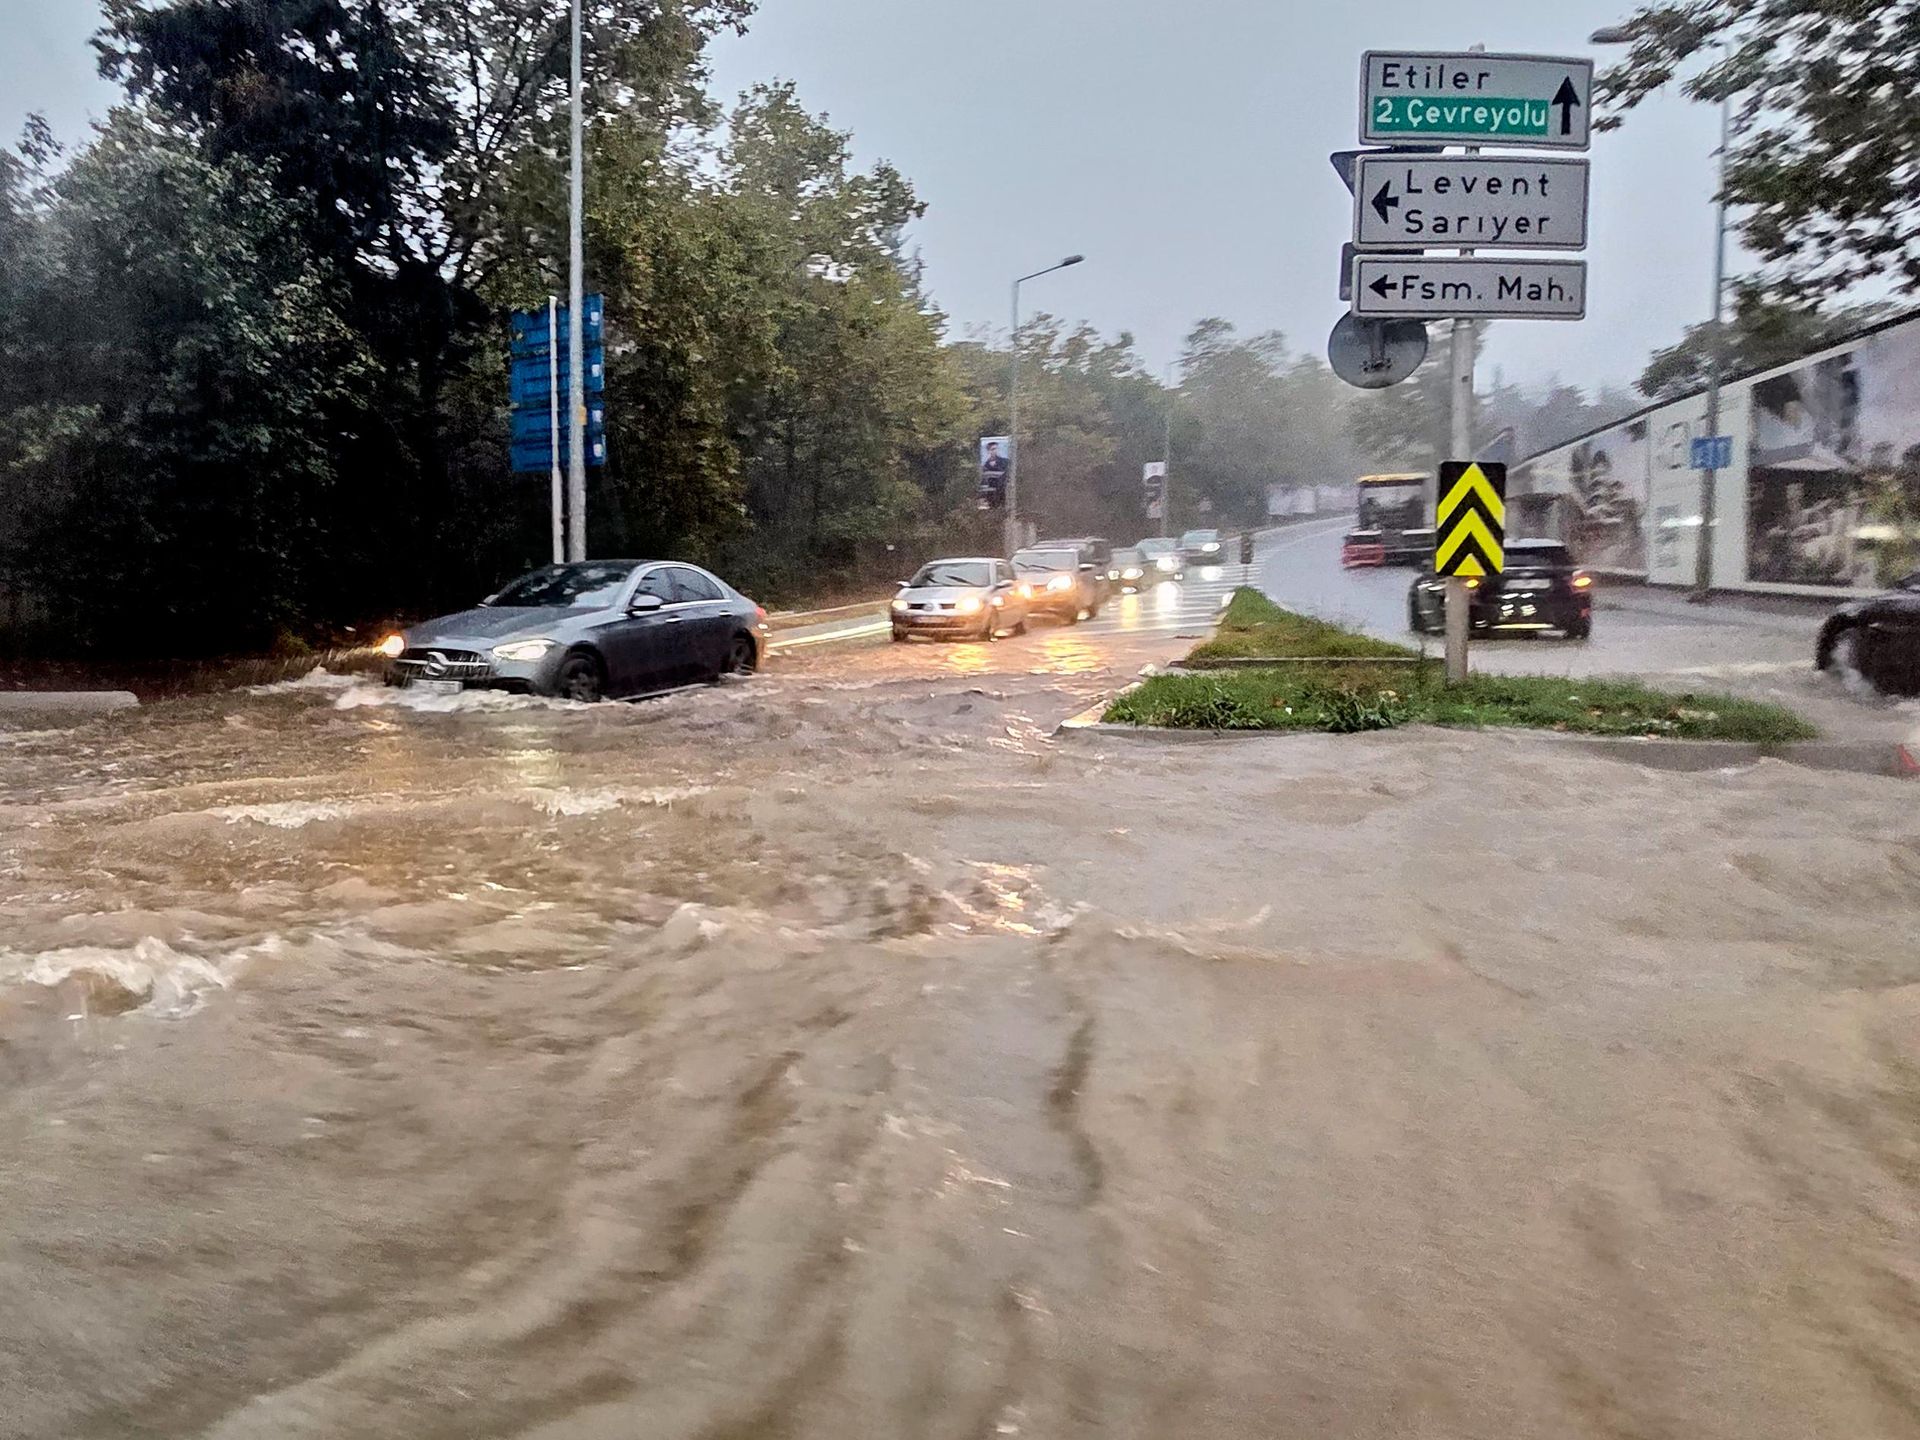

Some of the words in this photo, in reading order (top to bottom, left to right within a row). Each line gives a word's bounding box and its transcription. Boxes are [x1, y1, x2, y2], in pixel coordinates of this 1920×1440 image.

[1382, 63, 1490, 90] Etiler
[1375, 98, 1400, 124] 2.
[1406, 100, 1546, 131] Çevreyolu
[1406, 168, 1550, 196] Levent
[1404, 210, 1550, 240] Sarıyer
[1401, 274, 1483, 300] Fsm.
[1497, 275, 1574, 302] Mah.
